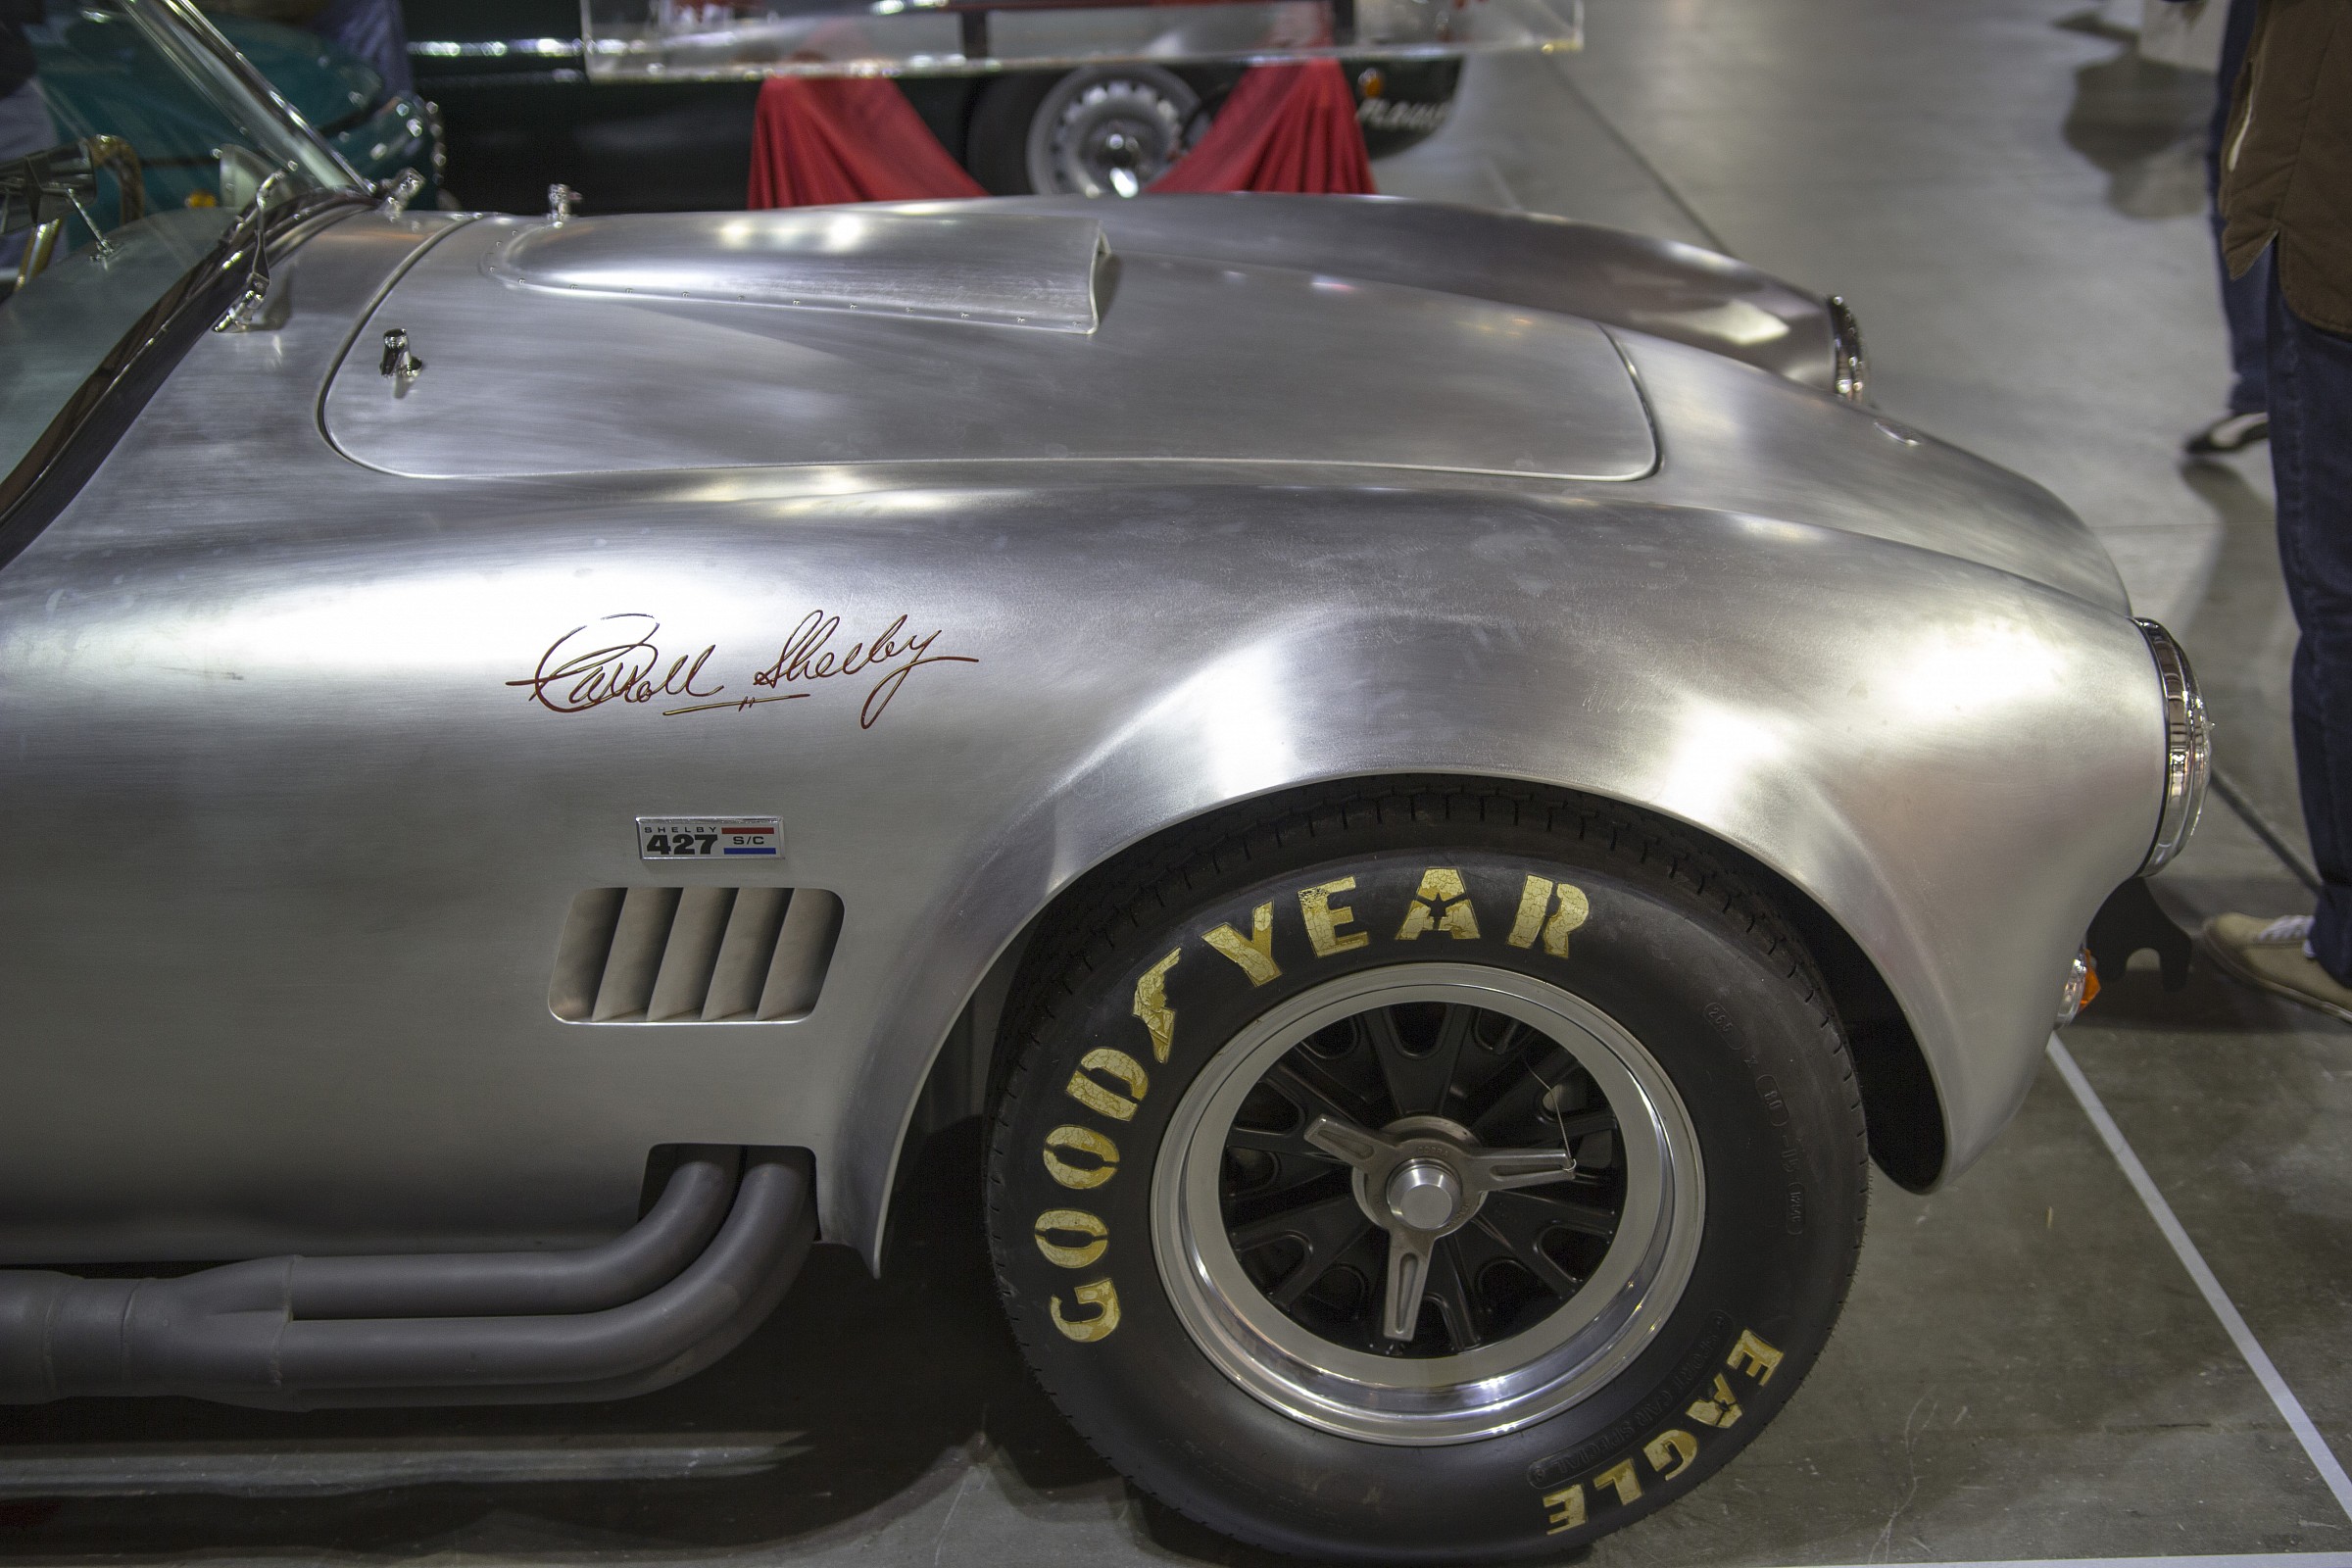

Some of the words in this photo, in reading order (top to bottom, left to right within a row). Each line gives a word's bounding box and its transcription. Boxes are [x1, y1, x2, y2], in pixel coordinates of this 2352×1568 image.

[753, 609, 979, 729] Shelby
[646, 834, 718, 855] 427
[733, 836, 764, 845] S/C
[1543, 1329, 1785, 1535] EAGLE
